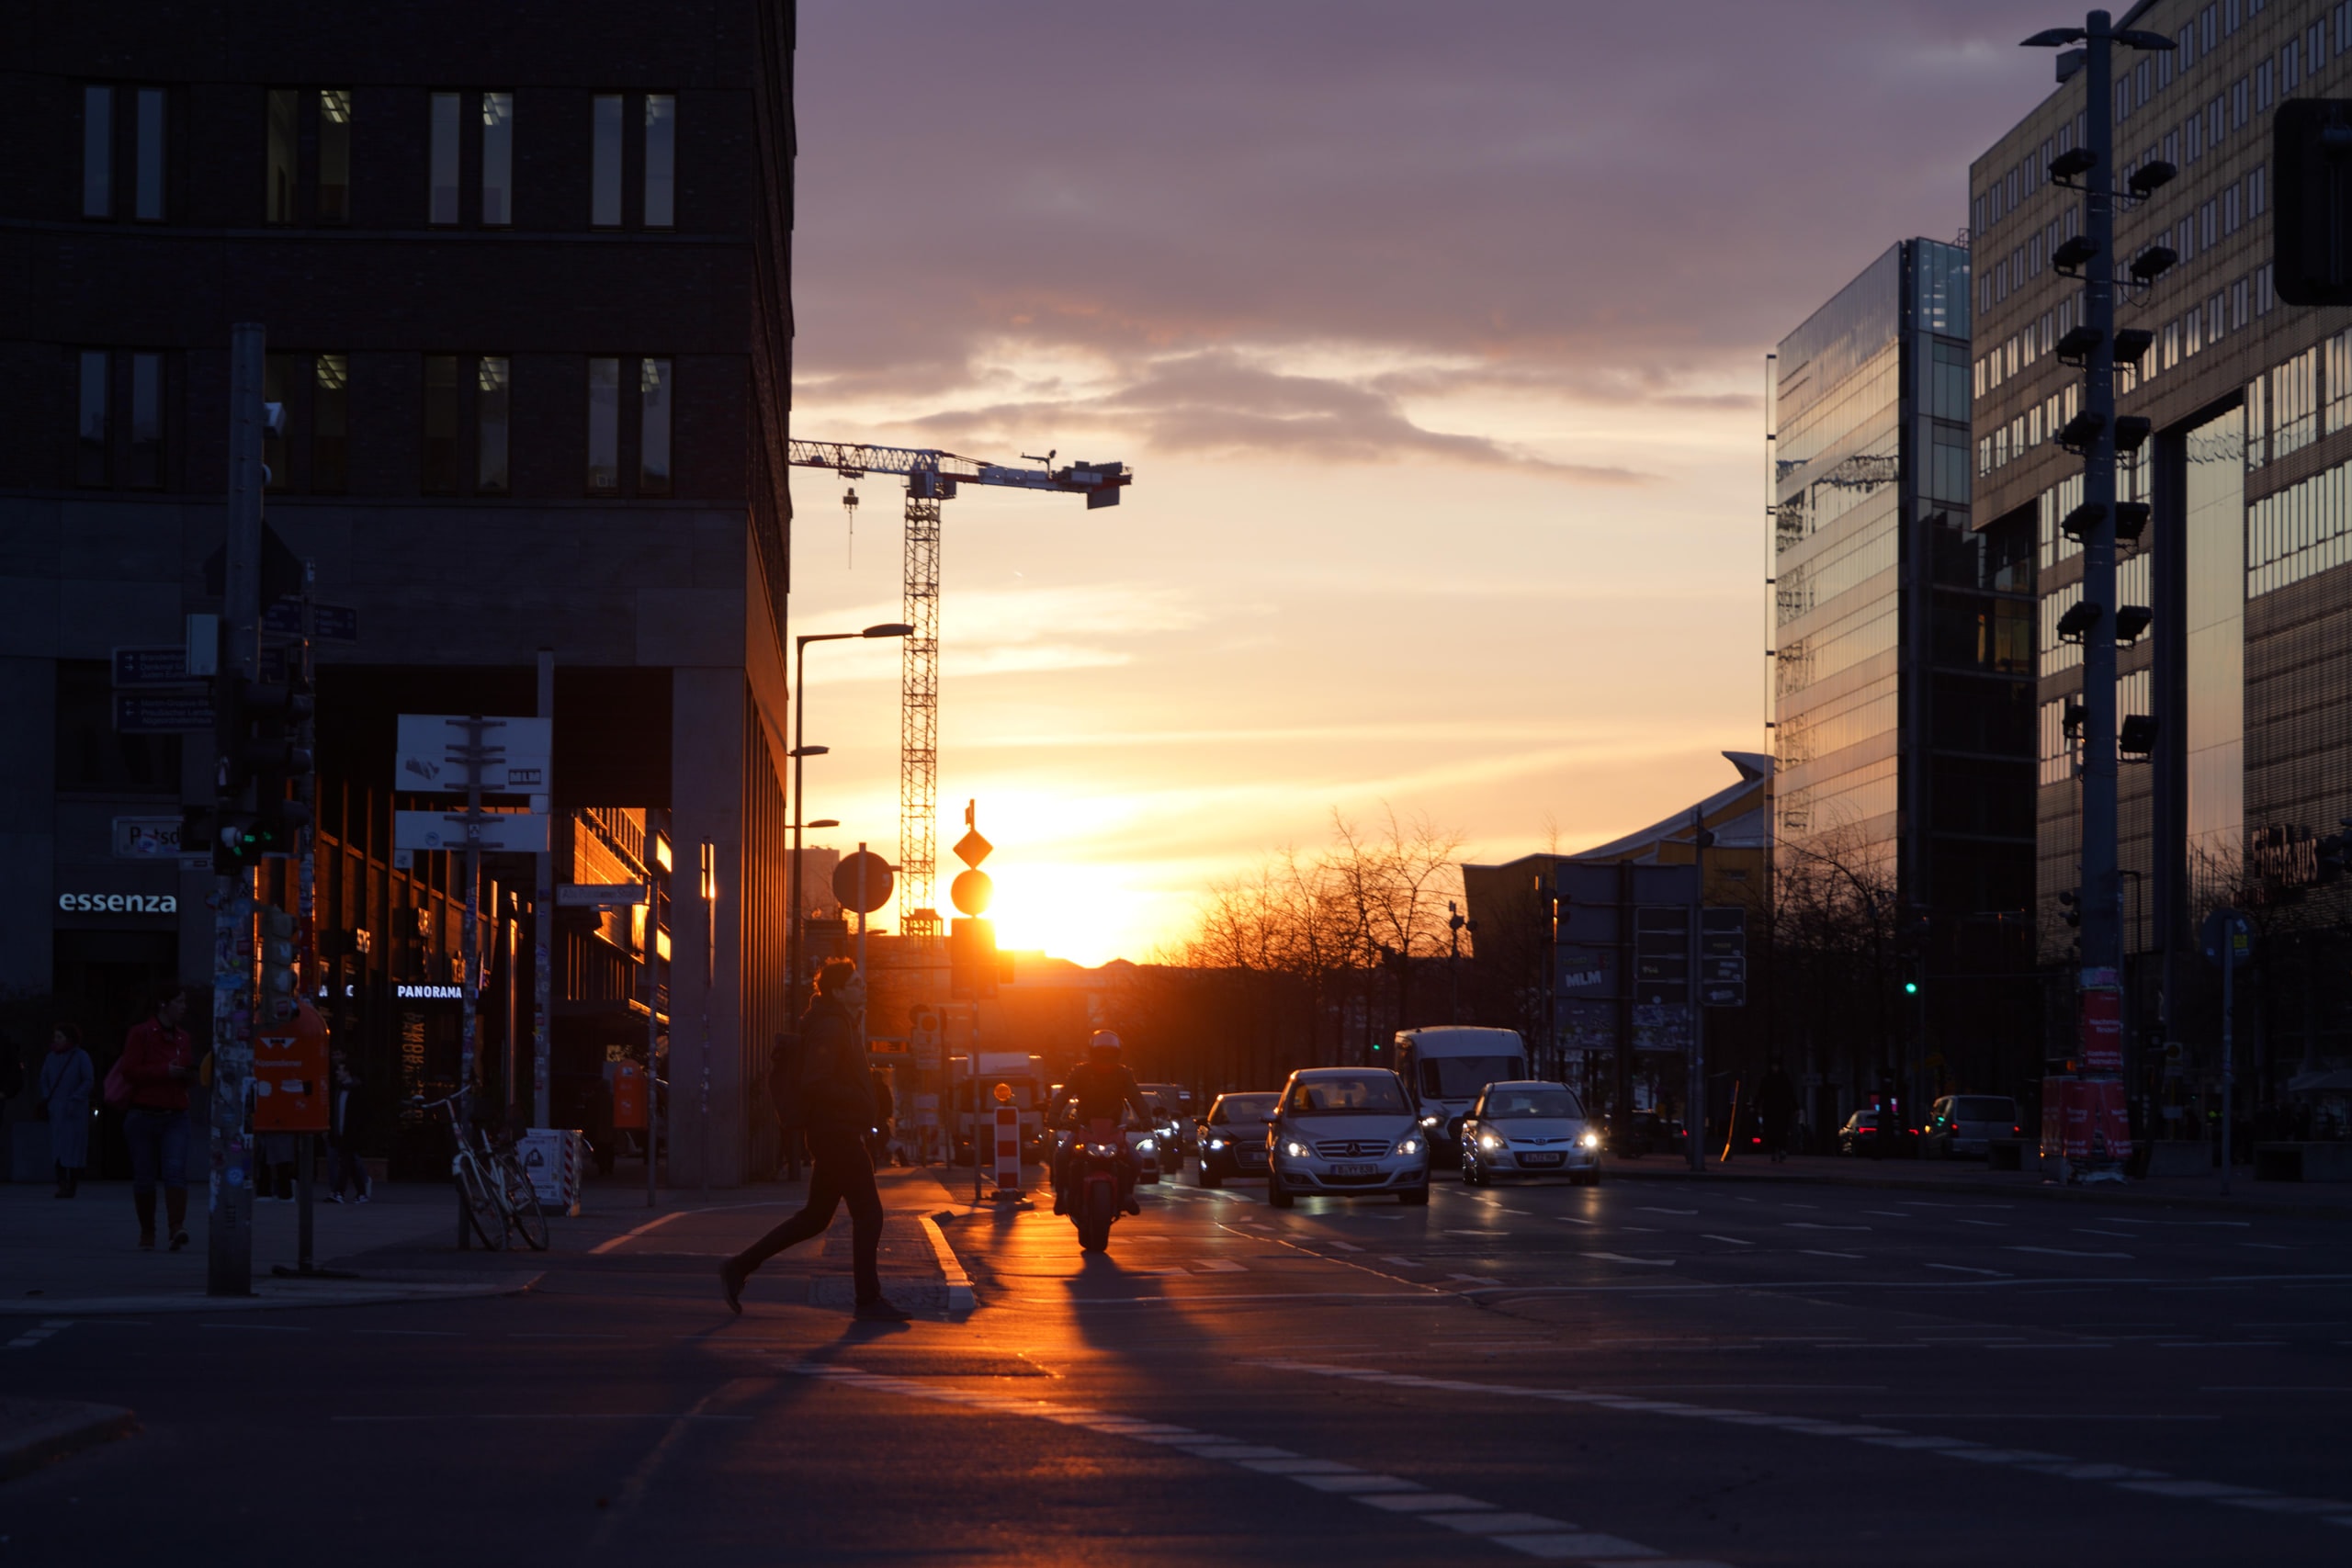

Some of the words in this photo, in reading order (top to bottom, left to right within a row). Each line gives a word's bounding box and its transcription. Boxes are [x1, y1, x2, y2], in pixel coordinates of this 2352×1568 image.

[130, 826, 181, 845] Ptsd
[58, 893, 177, 913] essenza
[1565, 970, 1602, 987] MLM
[397, 985, 462, 999] PANORAMA
